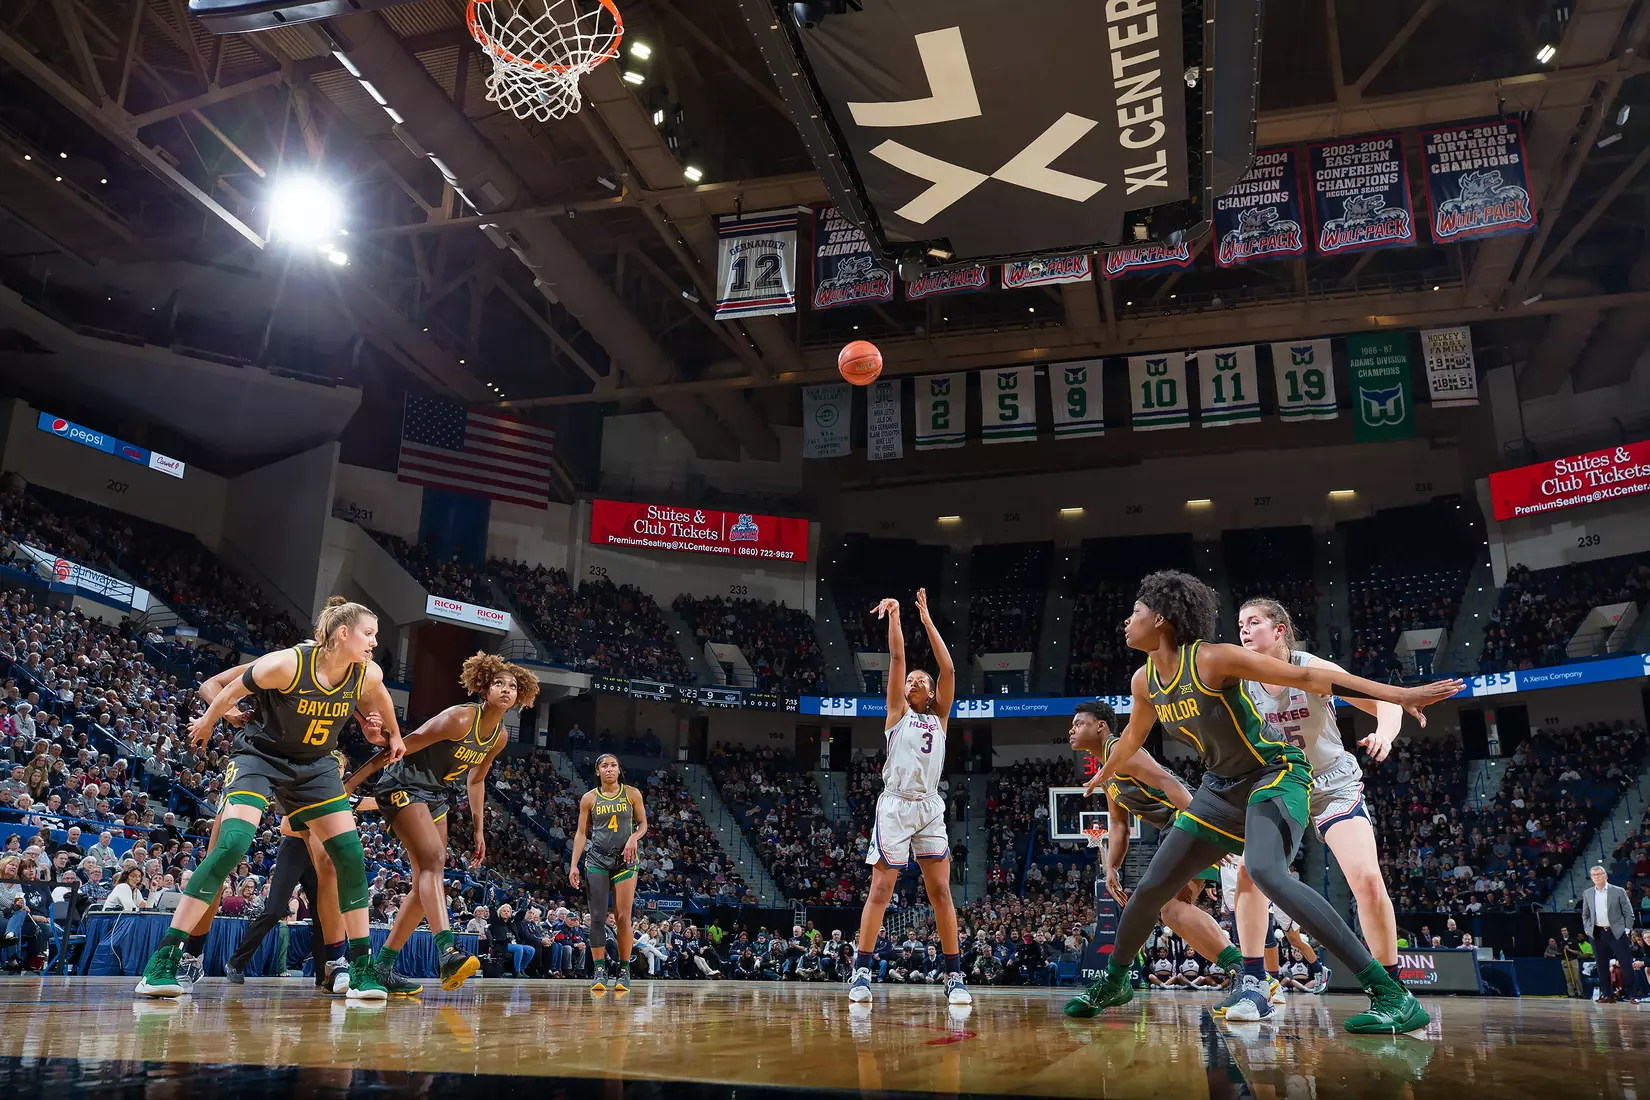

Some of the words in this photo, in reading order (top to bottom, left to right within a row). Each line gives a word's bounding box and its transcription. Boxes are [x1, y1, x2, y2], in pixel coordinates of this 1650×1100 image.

[1105, 0, 1165, 149] CENTER
[1433, 125, 1508, 143] 2014-2015
[1322, 139, 1393, 157] 2003-2004
[1427, 133, 1517, 155] NORTHEAST
[1325, 150, 1390, 168] EASTERN
[1439, 145, 1506, 163] DIVISION
[1124, 149, 1168, 195] XL
[1316, 161, 1399, 180] CONFERENCE
[1431, 153, 1519, 174] CHAMPIONS
[1242, 166, 1284, 180] ANTIC
[1316, 173, 1398, 192] CHAMPIONS
[1326, 188, 1359, 198] REGULAR
[1361, 184, 1389, 194] SEASON
[1217, 191, 1289, 210] CHAMPIONS
[828, 229, 866, 243] SEASO
[729, 239, 786, 256] GERNANDER
[817, 241, 872, 257] CHAMPIO
[731, 253, 782, 292] 12
[1429, 345, 1467, 354] FAMILY
[1350, 357, 1374, 368] ADAMS
[1376, 355, 1406, 366] DIVISION
[1358, 366, 1400, 378] CHAMPIONS
[1141, 379, 1177, 408] 10
[1212, 372, 1245, 403] 11
[1285, 368, 1326, 402] 19
[998, 393, 1019, 421] 5
[1067, 386, 1087, 418] 9
[932, 400, 950, 429] 2
[70, 427, 104, 447] pepsi
[1554, 455, 1610, 477] Suites
[1614, 446, 1631, 464] &
[106, 479, 130, 495] 207
[1541, 476, 1583, 496] Club
[1585, 463, 1650, 488] Tickets
[1254, 496, 1271, 506] 237
[355, 508, 373, 521] 231
[647, 505, 690, 523] Suites
[693, 509, 706, 524] &
[633, 519, 666, 537] Club
[669, 523, 718, 540] Tickets
[608, 535, 730, 554] PremiumSeating@XLCenter.com
[738, 546, 758, 558] (860)
[760, 549, 794, 560] 722-9637
[1577, 534, 1601, 549] 239
[589, 565, 607, 577] 232
[729, 584, 748, 596] 233
[434, 599, 462, 611] RICOH
[477, 609, 504, 620] RICOH
[1472, 673, 1511, 688] CBS
[1529, 674, 1549, 684] Xerox
[1550, 671, 1583, 682] Company
[659, 685, 665, 694] 8
[679, 688, 698, 699] 4:23
[707, 691, 714, 700] 9
[296, 698, 350, 718] BAYLOR
[820, 697, 855, 709] CBS
[957, 699, 991, 711] CBS
[1006, 703, 1022, 711] Xerox
[1023, 702, 1048, 714] Company
[1154, 697, 1201, 723] BAYLOR
[1544, 716, 1560, 725] 111
[302, 719, 334, 746] 15
[769, 732, 785, 740] 108
[1052, 737, 1069, 745] 109
[921, 732, 933, 754] 3
[443, 764, 468, 781] 2
[596, 802, 628, 816] BAYLOR
[607, 814, 618, 833] 4
